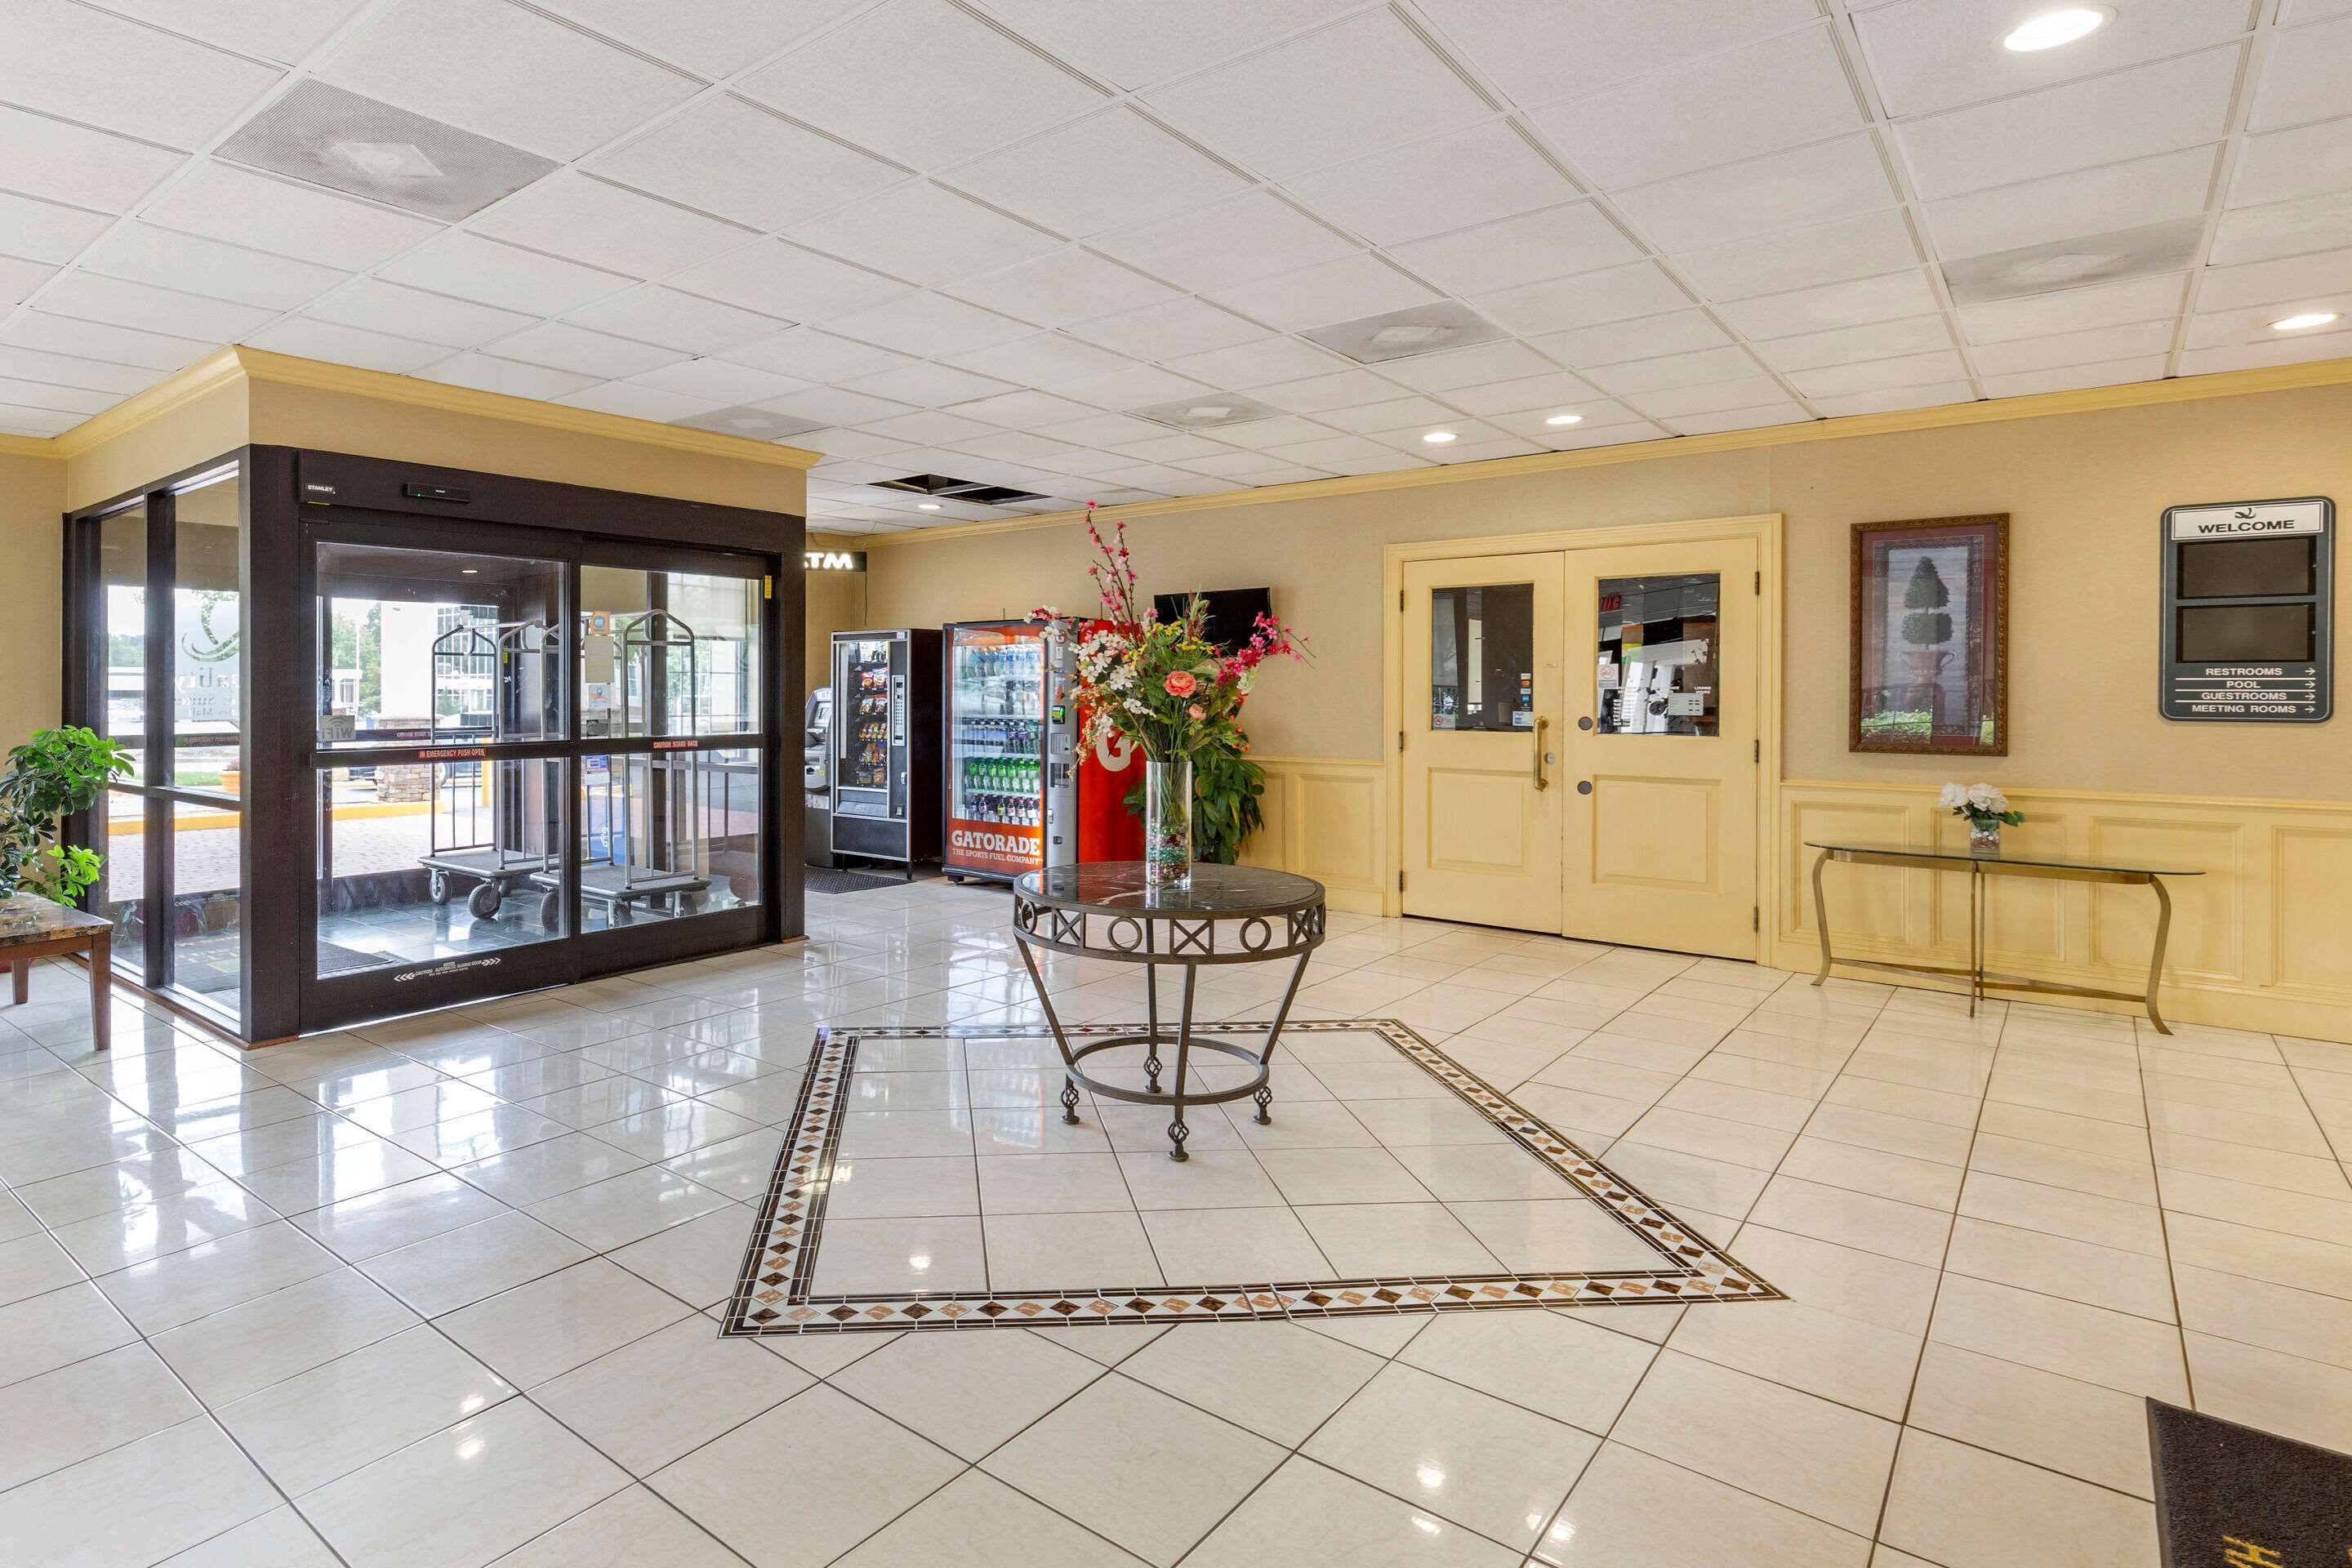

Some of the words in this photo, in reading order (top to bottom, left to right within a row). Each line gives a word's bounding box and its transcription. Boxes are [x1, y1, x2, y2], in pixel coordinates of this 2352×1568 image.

[2198, 519, 2295, 533] WELCOME
[804, 553, 853, 569] TM
[2206, 667, 2283, 676] RESTROOMS
[2226, 680, 2261, 688] POOL
[2201, 692, 2287, 701] GUESTROOMS
[2191, 705, 2245, 713] MEETING
[2251, 705, 2296, 713] ROOMS
[425, 749, 457, 758] EMERGENCY
[471, 748, 486, 756] OPEN
[951, 830, 1040, 856] GATORADE
[965, 849, 988, 859] SPORTS
[989, 852, 1005, 862] FUEL
[1006, 854, 1040, 865] COMPANY
